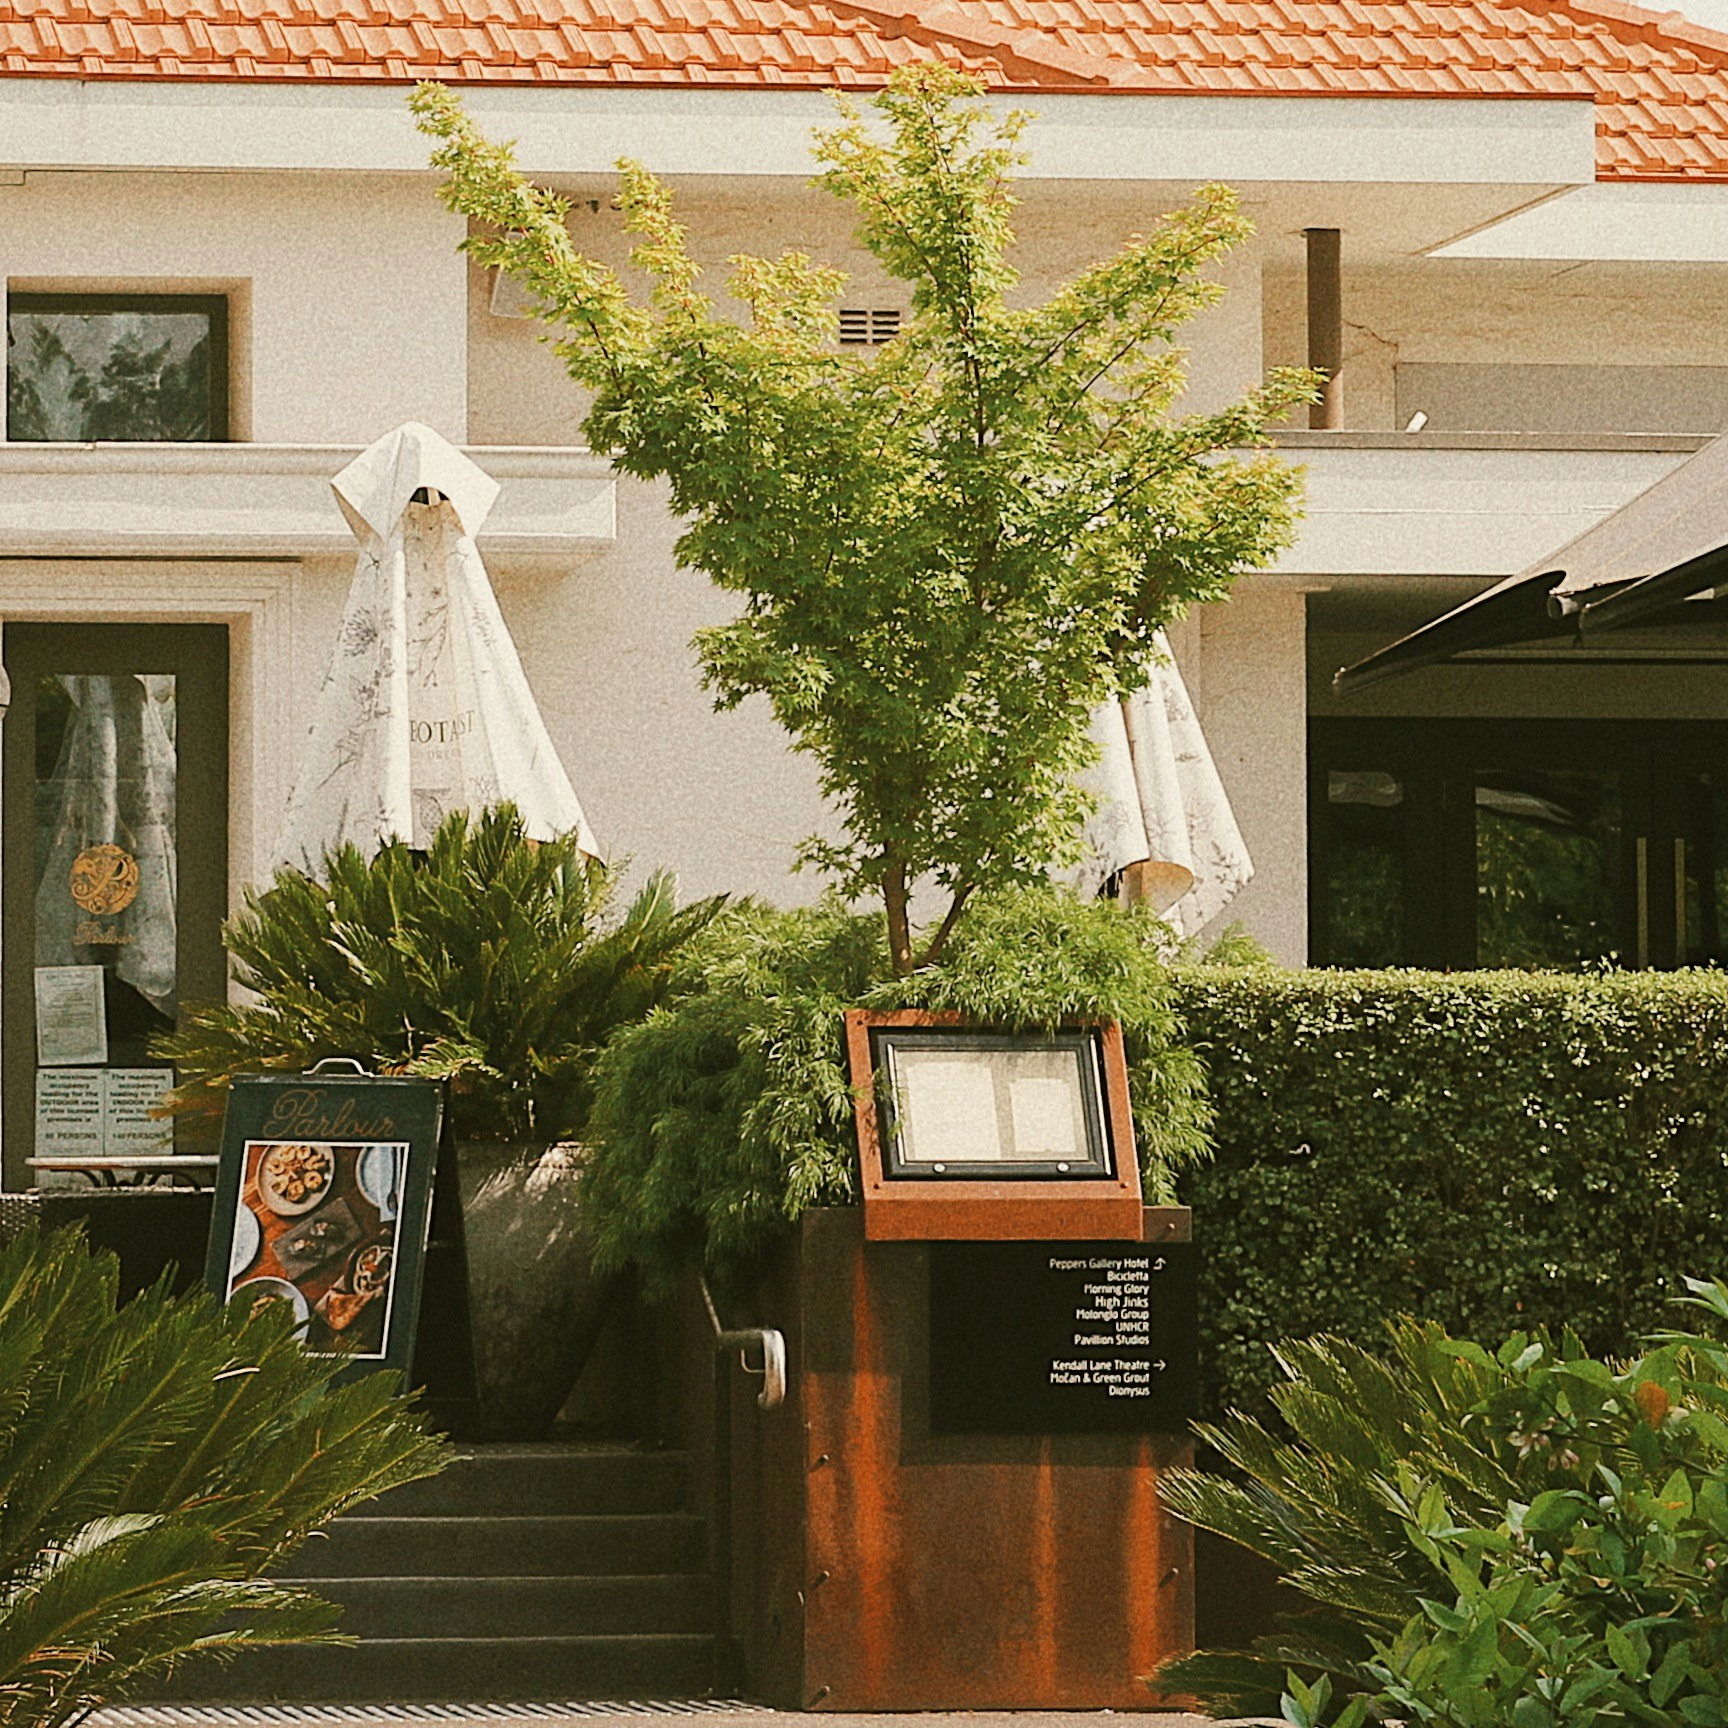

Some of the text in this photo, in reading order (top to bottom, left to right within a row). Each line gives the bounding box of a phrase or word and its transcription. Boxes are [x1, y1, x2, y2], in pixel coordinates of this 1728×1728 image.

[263, 1089, 394, 1138] Parlour
[1049, 1258, 1149, 1270] Peppers Gallery Hotel
[1083, 1283, 1150, 1296] Morning Glory
[1095, 1296, 1149, 1310] High Jinks
[1120, 1308, 1150, 1320] Group
[1115, 1321, 1150, 1332] UNHCR
[1115, 1334, 1150, 1346] Studios
[1052, 1359, 1150, 1371] Kendall Lane Theatre
[1082, 1372, 1091, 1383] &
[1092, 1372, 1122, 1383] Green
[1123, 1372, 1150, 1383] Grout
[1108, 1385, 1150, 1398] Dionysus
